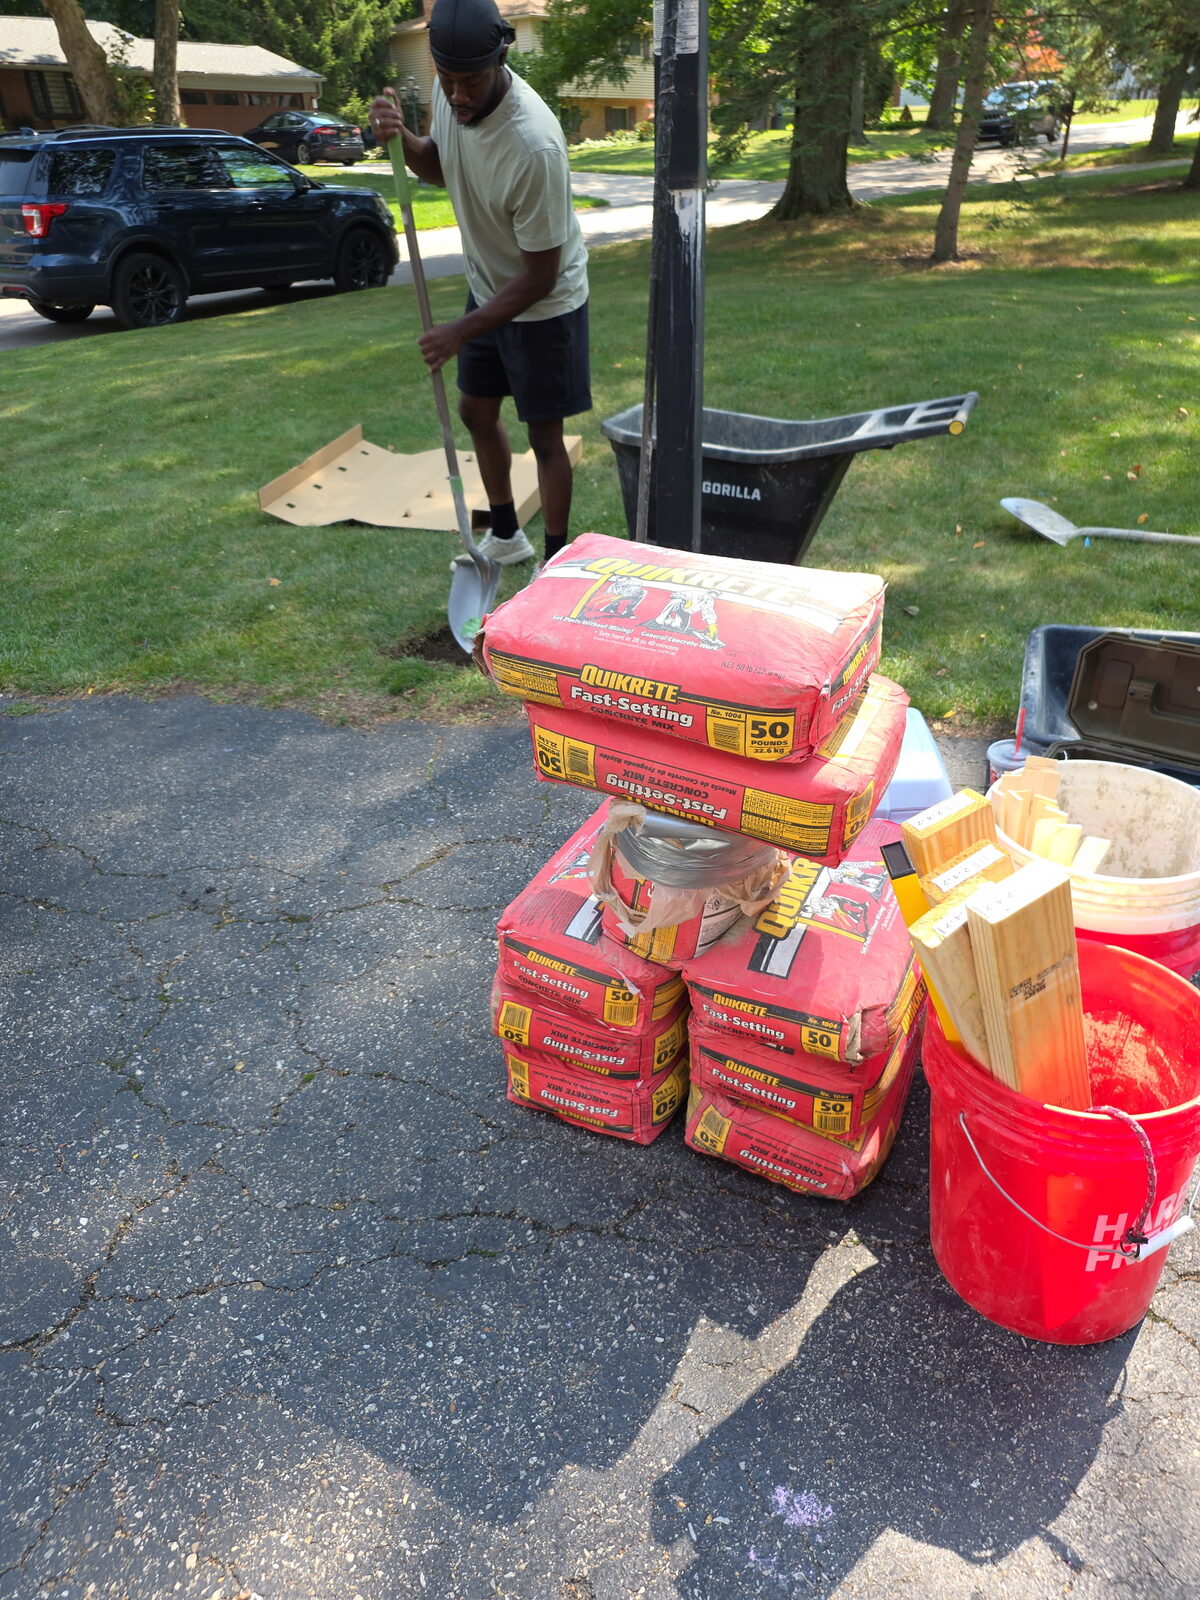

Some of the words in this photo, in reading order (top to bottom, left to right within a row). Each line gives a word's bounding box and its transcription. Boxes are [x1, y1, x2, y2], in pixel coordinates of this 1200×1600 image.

[702, 481, 761, 501] GORILLA
[584, 557, 808, 606] QUIKRETE
[552, 614, 563, 622] Set
[562, 616, 580, 626] Posts
[581, 619, 609, 630] Without
[608, 624, 634, 634] Mixing!
[611, 632, 625, 641] hard
[640, 630, 669, 641] General
[668, 635, 698, 648] Concrete
[699, 641, 719, 651] Work
[721, 661, 735, 669] NET
[736, 663, 746, 671] 50
[581, 664, 680, 703] QUIKRETE
[571, 686, 694, 727] Fast-Setting
[711, 709, 722, 717] No.
[724, 712, 743, 720] 1004
[590, 706, 648, 725] CONCRETE
[651, 720, 675, 731] MIX
[750, 720, 790, 739] 50
[773, 747, 785, 755] kg
[538, 751, 563, 774] 50
[623, 759, 656, 774] Fraguado
[657, 768, 666, 776] de
[622, 769, 645, 782] MIX
[667, 769, 699, 785] Concreto
[605, 774, 728, 820] Fast-Setting
[648, 776, 709, 799] CONCRETE
[710, 784, 737, 796] Mezcla
[849, 815, 866, 834] 50
[752, 857, 824, 940] QUIKR
[526, 950, 578, 977] QUIKRETE
[513, 960, 589, 999] Fast-Setting
[518, 975, 561, 997] CONCRETE
[563, 995, 582, 1005] MIX
[611, 991, 634, 1001] 50
[712, 993, 768, 1018] QUIKRETE
[702, 1003, 785, 1040] Fast-Setting
[709, 1020, 756, 1038] CONCRETE
[821, 1020, 838, 1029] 1004
[504, 1030, 524, 1042] 50
[550, 1029, 569, 1041] MIX
[570, 1036, 620, 1053] CONCRETE
[808, 1031, 832, 1047] 50
[543, 1036, 626, 1065] Fast-Setting
[656, 1046, 678, 1065] 50
[725, 1059, 780, 1087] QUIKRETE
[513, 1077, 526, 1094] 50
[546, 1082, 564, 1093] MIX
[712, 1068, 797, 1109] Fast-Setting
[540, 1089, 619, 1117] Fast-Setting
[565, 1087, 610, 1104] CONCRETE
[718, 1082, 767, 1105] CONCRETE
[769, 1103, 789, 1113] MIX
[655, 1095, 677, 1116] 50
[820, 1101, 845, 1112] 50
[699, 1132, 719, 1149] 50
[749, 1144, 770, 1156] MIX
[738, 1148, 828, 1189] Fast-Setting
[771, 1153, 824, 1177] CONCRETE
[1092, 1183, 1188, 1243] HAR
